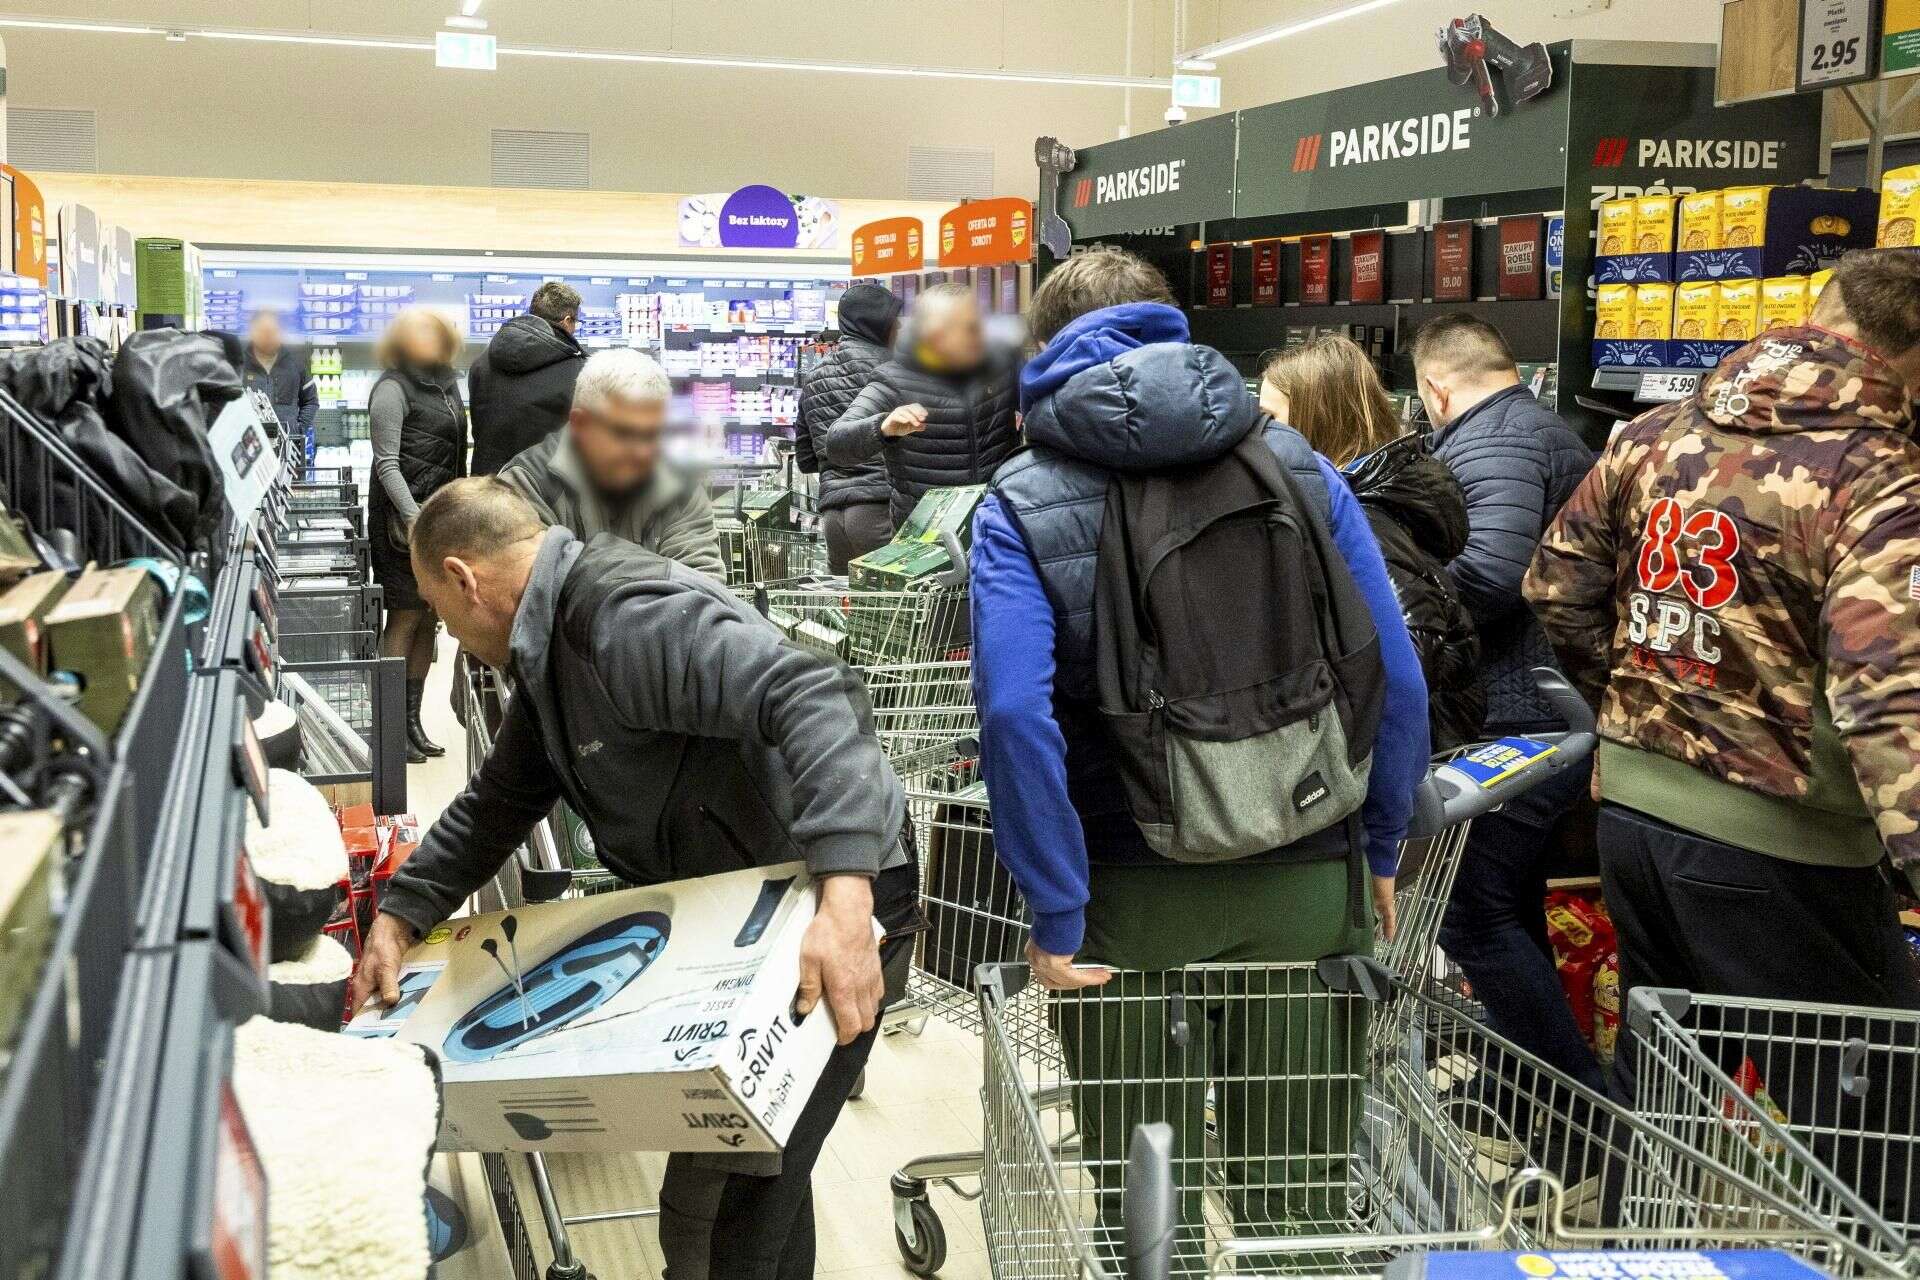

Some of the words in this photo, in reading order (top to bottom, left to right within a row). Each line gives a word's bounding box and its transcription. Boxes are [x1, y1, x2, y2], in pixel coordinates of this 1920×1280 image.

[1811, 37, 1859, 70] 2.95
[1330, 108, 1471, 167] PARKSIDE
[1638, 139, 1778, 169] PARKSIDE
[1096, 160, 1180, 204] PARKSIDE
[729, 215, 748, 225] Bez
[750, 215, 788, 228] laktozy
[1504, 242, 1533, 253] ZAKUPY
[1442, 276, 1462, 288] 19.00
[1668, 377, 1695, 392] 5.99
[1637, 497, 1740, 610] 83
[1628, 592, 1722, 664] SPC
[1300, 787, 1325, 807] adidas
[712, 973, 755, 992] DINGHY
[662, 1020, 728, 1042] CRIVIT
[741, 1016, 788, 1099] CRIVIT
[682, 1112, 749, 1129] CRIVIT
